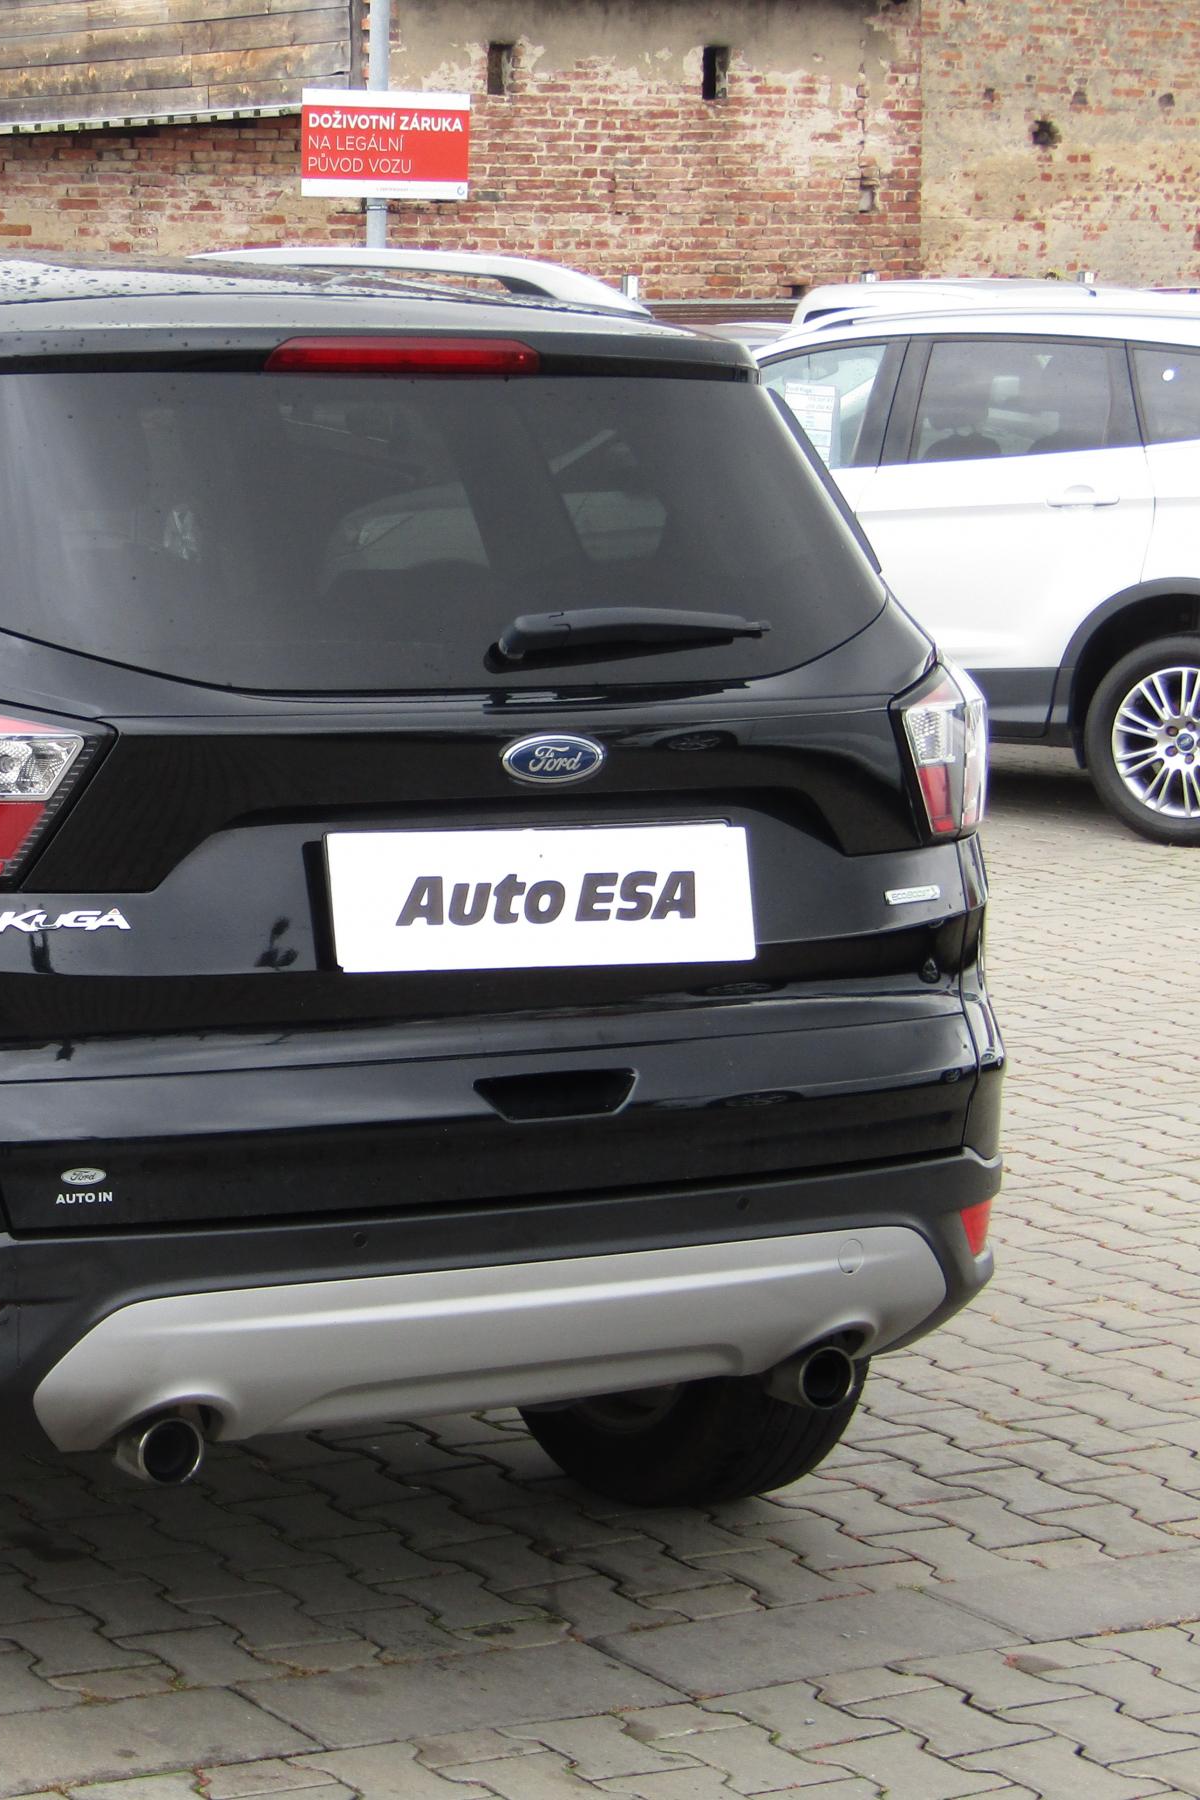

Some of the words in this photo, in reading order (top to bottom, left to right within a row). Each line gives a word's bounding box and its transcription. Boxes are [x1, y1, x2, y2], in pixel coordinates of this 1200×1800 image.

[308, 111, 395, 130] DOŽIVOTNÍ
[400, 113, 463, 132] ZÁRUKA
[308, 135, 331, 150] NA
[336, 134, 404, 152] LEGÁLNÍ
[308, 153, 364, 173] PŮVOD
[368, 158, 412, 174] VOZU
[528, 746, 582, 772] Ford
[396, 874, 566, 926] Auto
[575, 870, 696, 922] ESA
[55, 1192, 96, 1205] AUTO
[98, 1191, 113, 1202] IN
